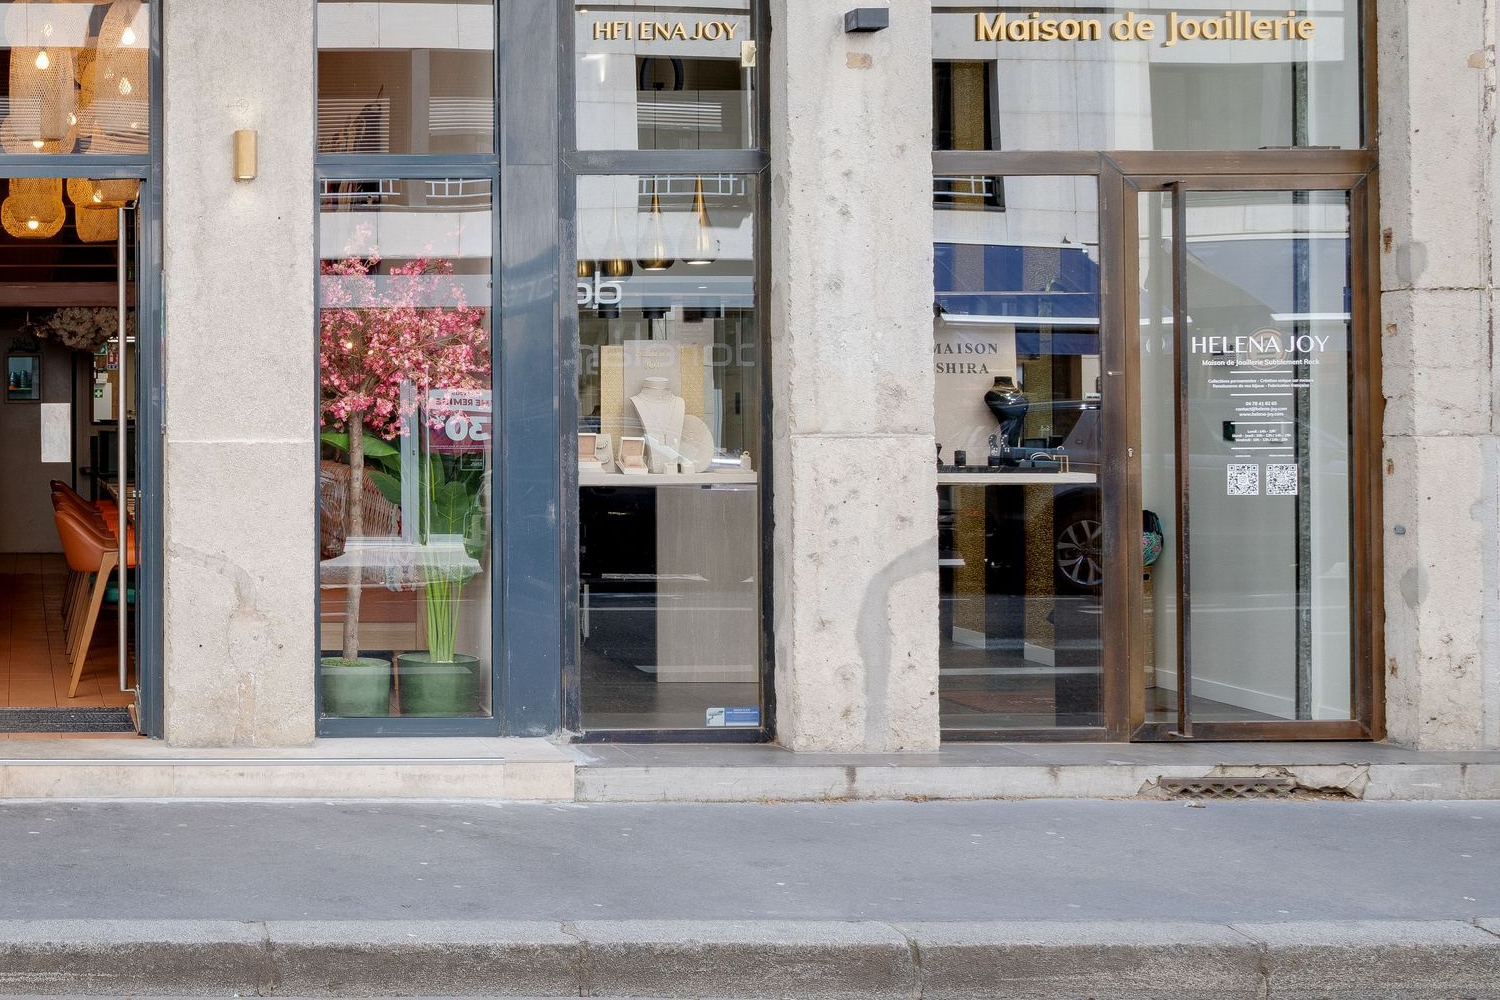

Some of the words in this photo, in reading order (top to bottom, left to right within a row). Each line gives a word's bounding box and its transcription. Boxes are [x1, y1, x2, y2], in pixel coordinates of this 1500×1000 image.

[690, 21, 739, 41] JOY
[975, 11, 1102, 42] Maison
[1111, 11, 1155, 42] de
[1162, 10, 1317, 48] Joaillerie
[933, 342, 998, 355] MAISON
[1191, 335, 1281, 354] HELENA
[1285, 335, 1329, 353] JOY
[936, 362, 990, 375] SHIRA
